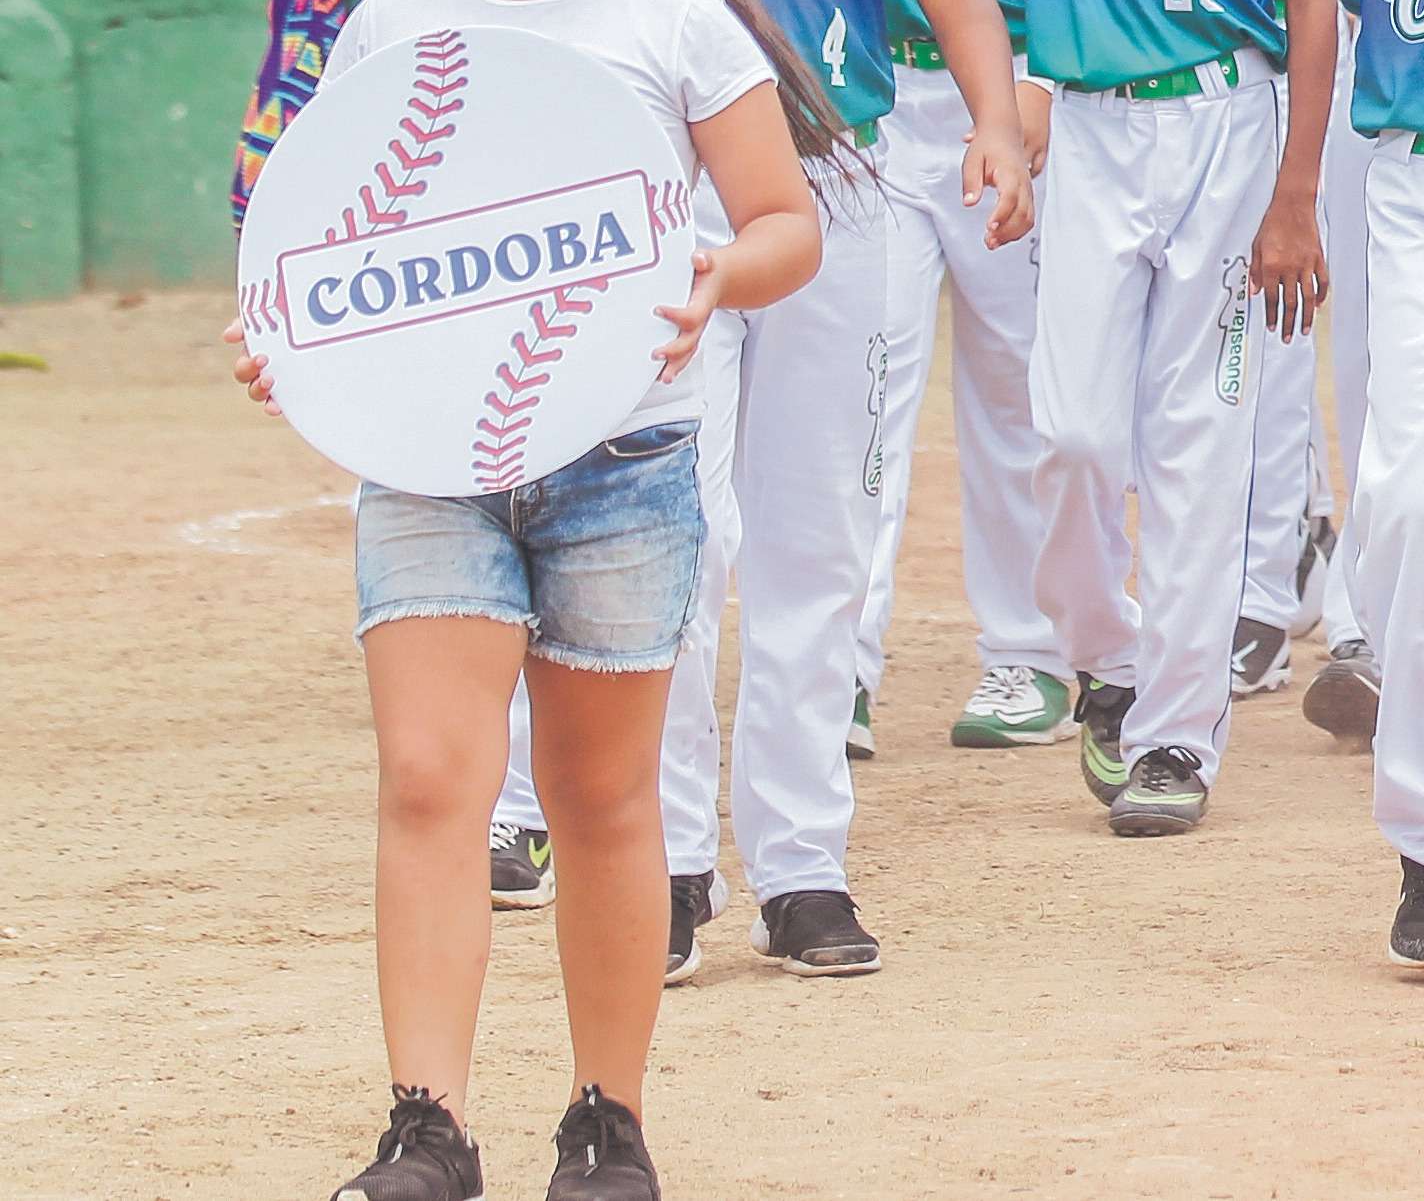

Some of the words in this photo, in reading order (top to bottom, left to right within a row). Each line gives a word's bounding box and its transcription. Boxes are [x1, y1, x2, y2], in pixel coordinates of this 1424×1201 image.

[821, 7, 848, 88] 4
[307, 211, 636, 326] CÓRDOBA
[1221, 307, 1245, 395] Subastar
